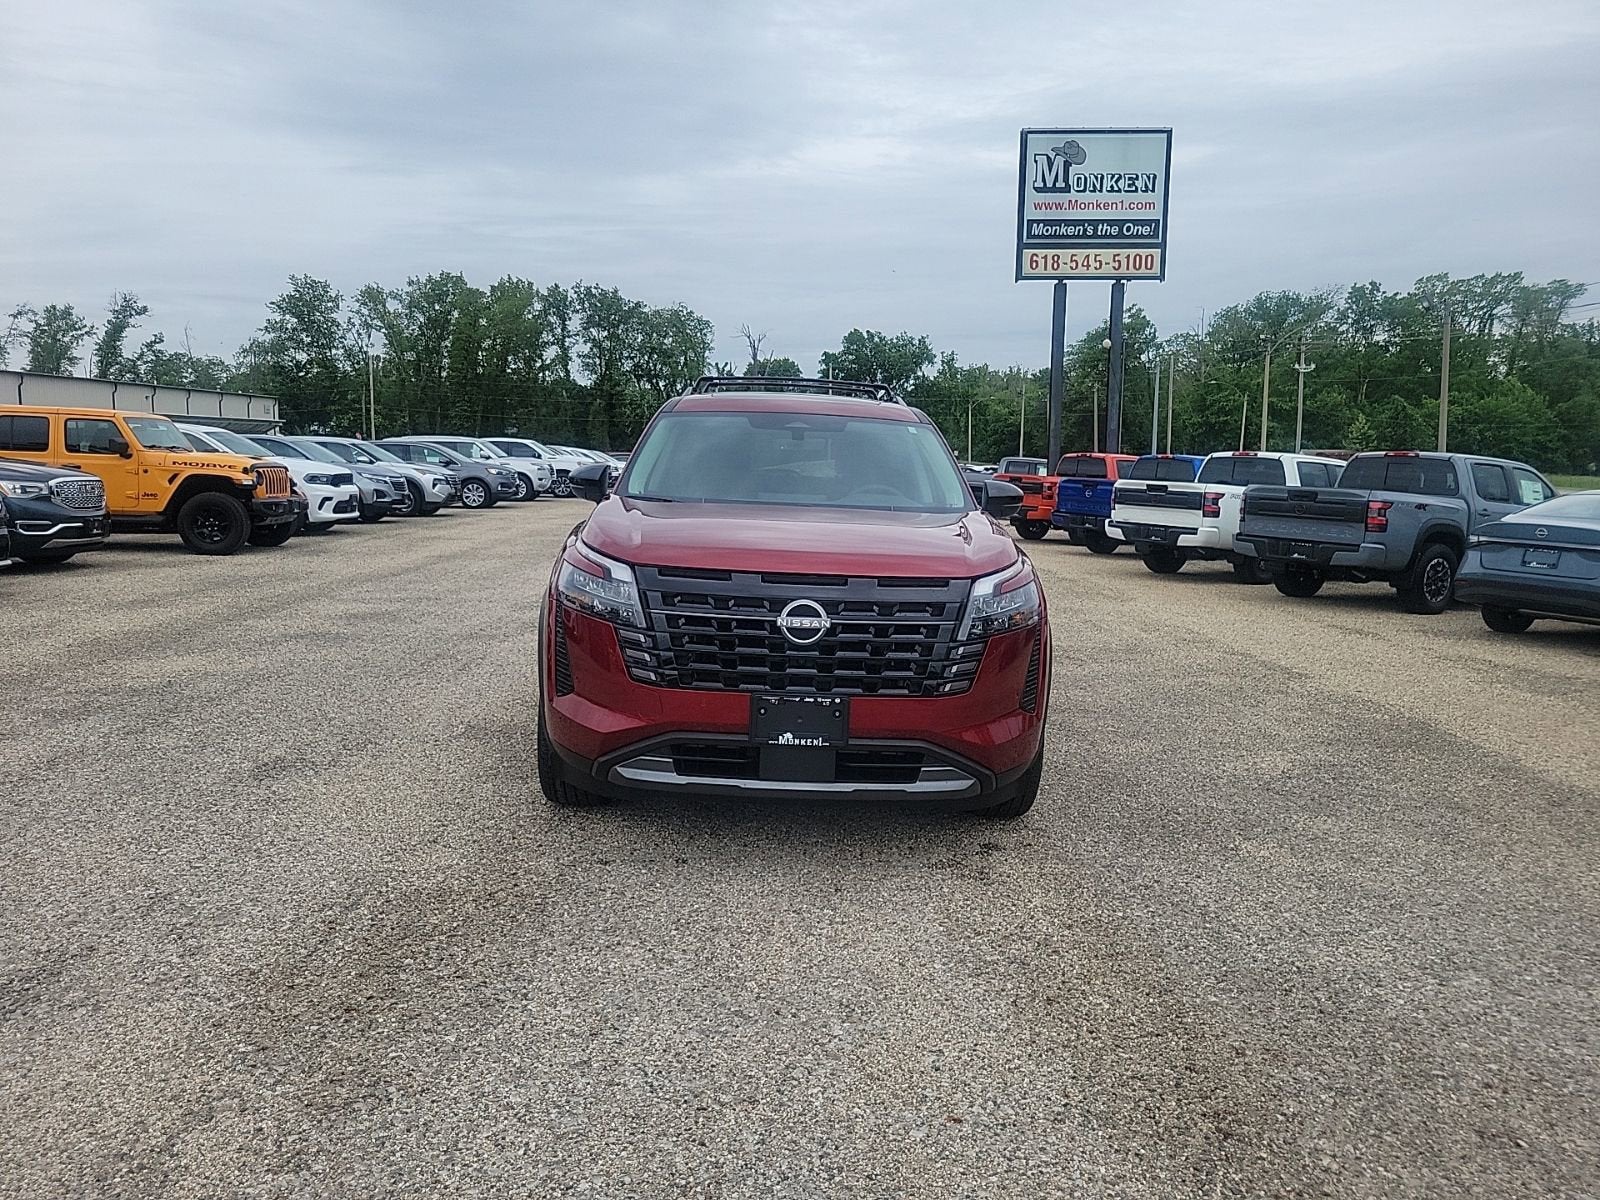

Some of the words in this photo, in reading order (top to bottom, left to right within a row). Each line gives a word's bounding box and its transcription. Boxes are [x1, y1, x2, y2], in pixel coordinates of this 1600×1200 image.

[1033, 154, 1157, 193] MONKEN
[1033, 199, 1155, 211] www.Monken1.com
[1031, 223, 1094, 236] Monken's
[1097, 223, 1118, 236] the
[1123, 223, 1155, 236] One!
[1029, 252, 1155, 271] 618-545-5100
[172, 460, 238, 470] MOJAVE
[777, 618, 831, 628] NISSAN
